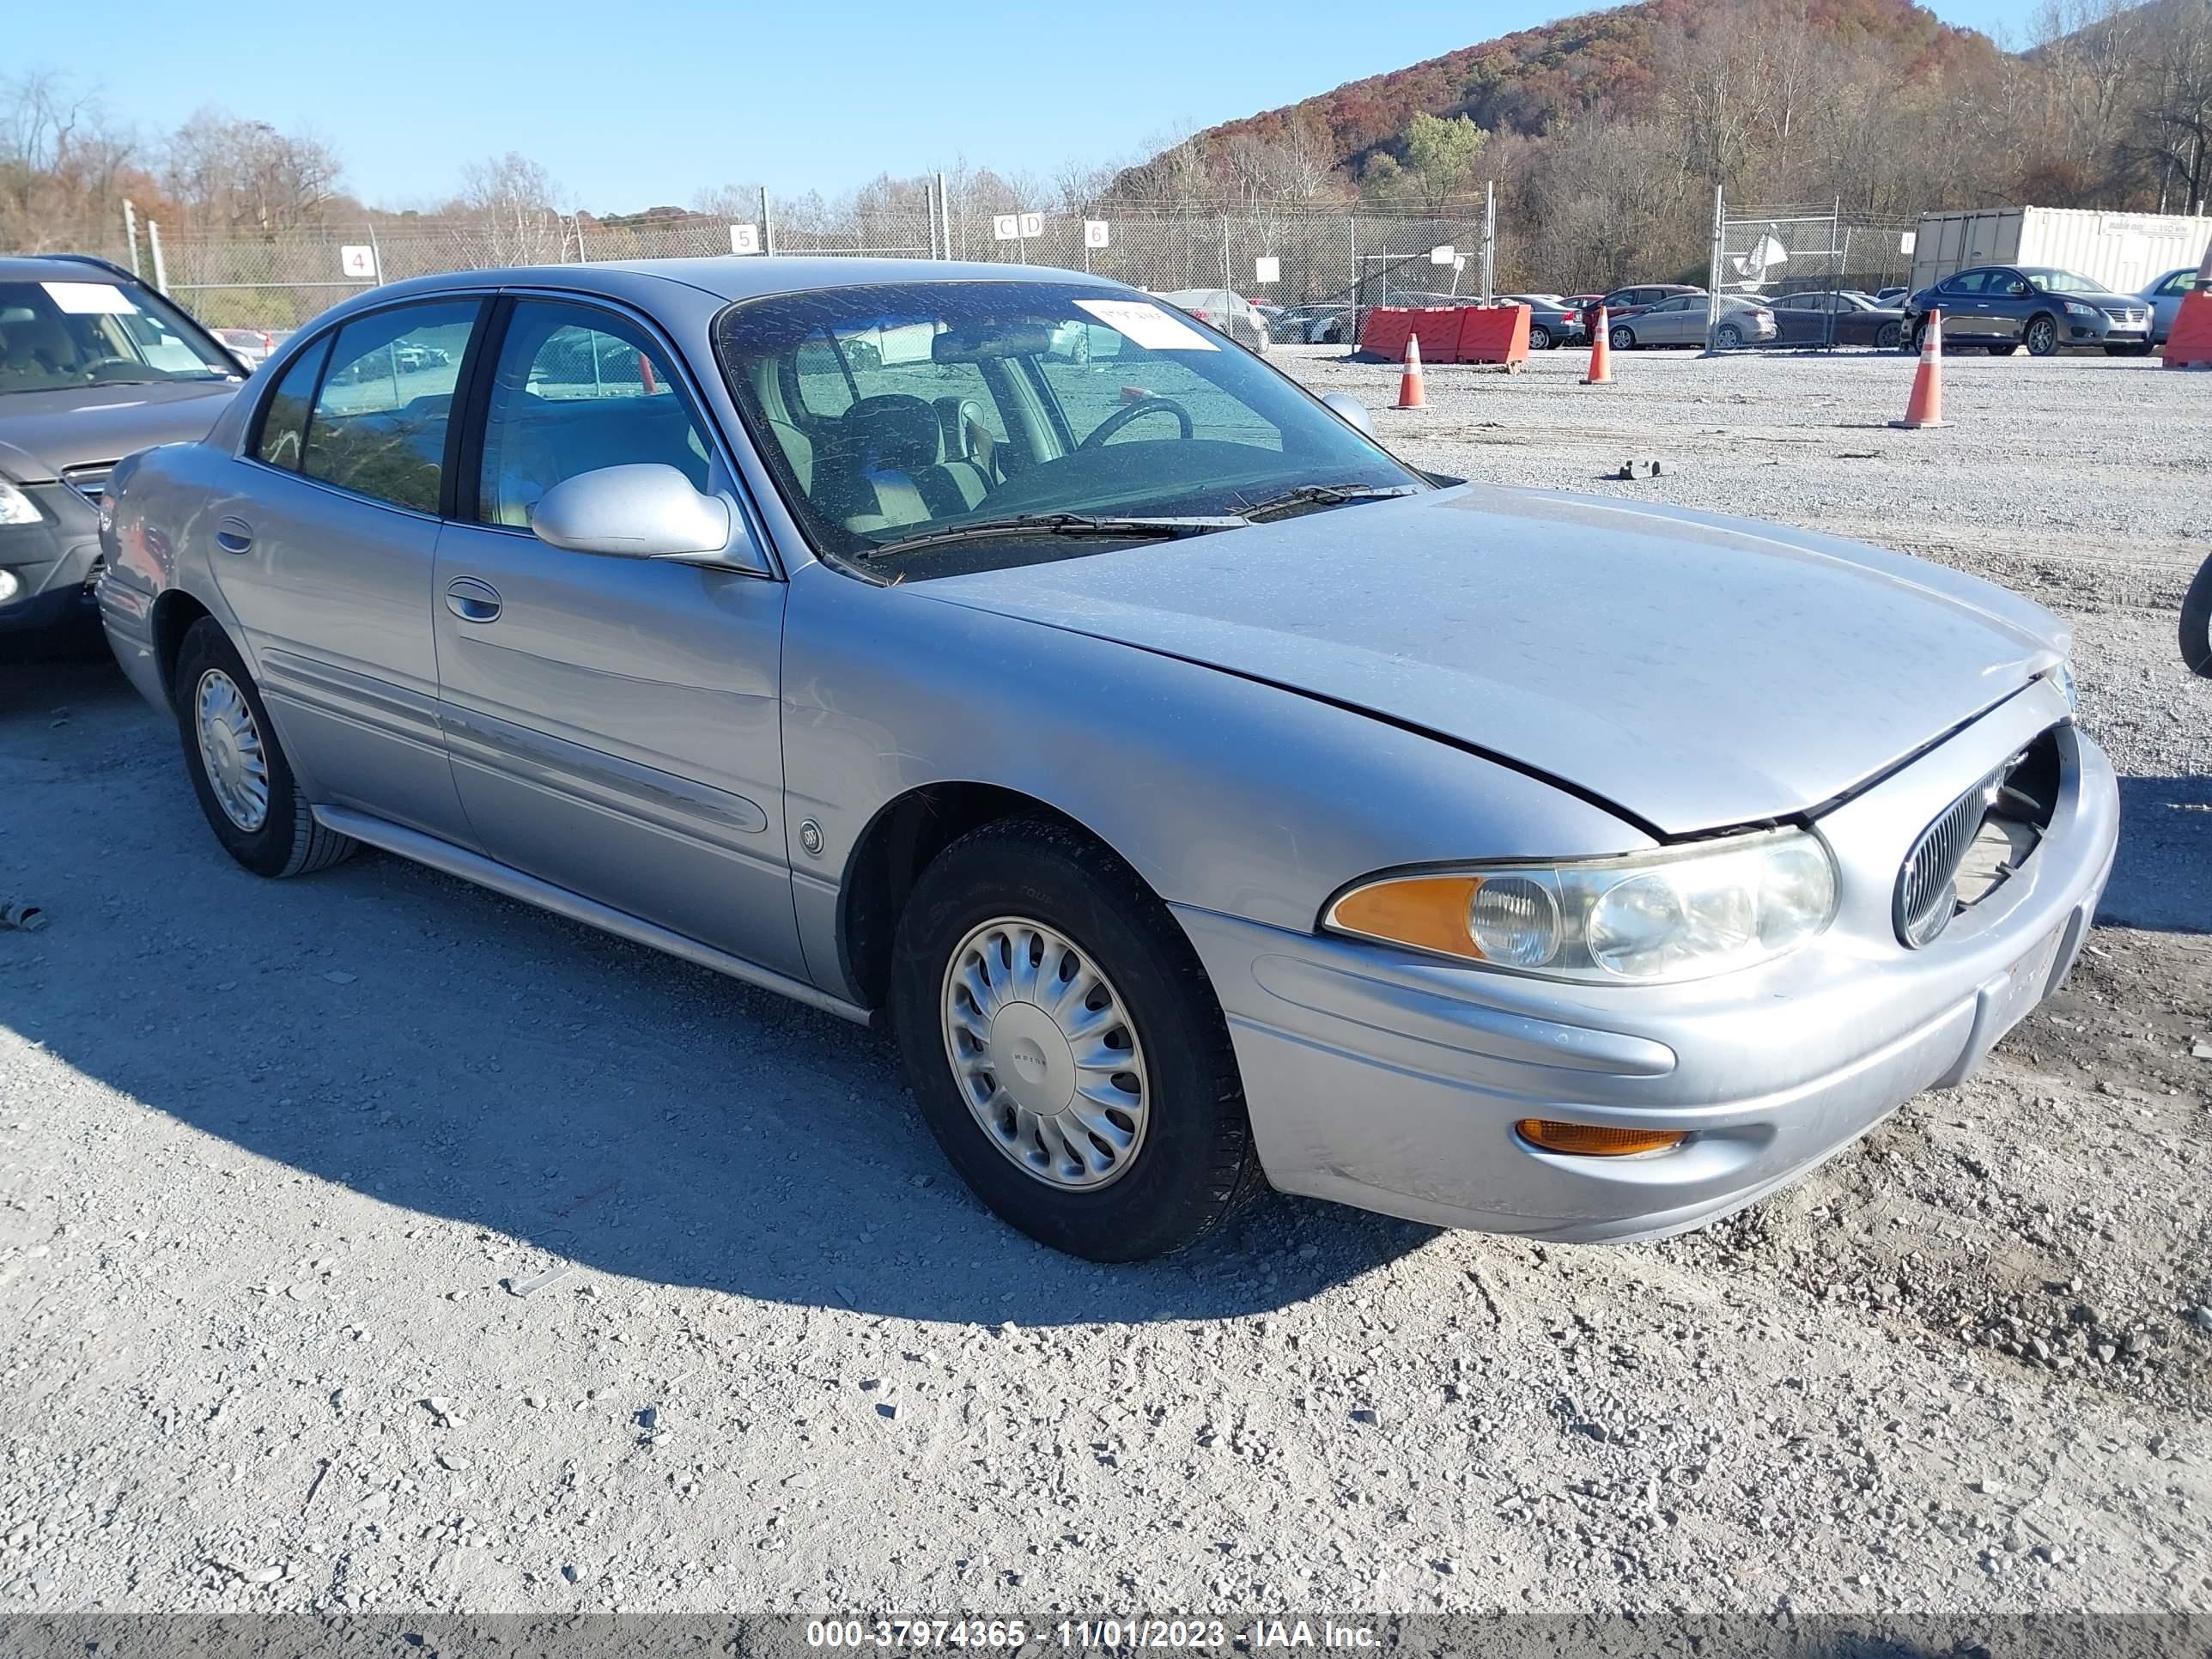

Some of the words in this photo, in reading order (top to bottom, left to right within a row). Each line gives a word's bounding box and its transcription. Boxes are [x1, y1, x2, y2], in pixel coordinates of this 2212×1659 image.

[1000, 218, 1013, 235] C
[1027, 216, 1040, 233] D
[738, 230, 750, 247] 5
[1091, 226, 1102, 242] 6
[352, 253, 365, 270] 4
